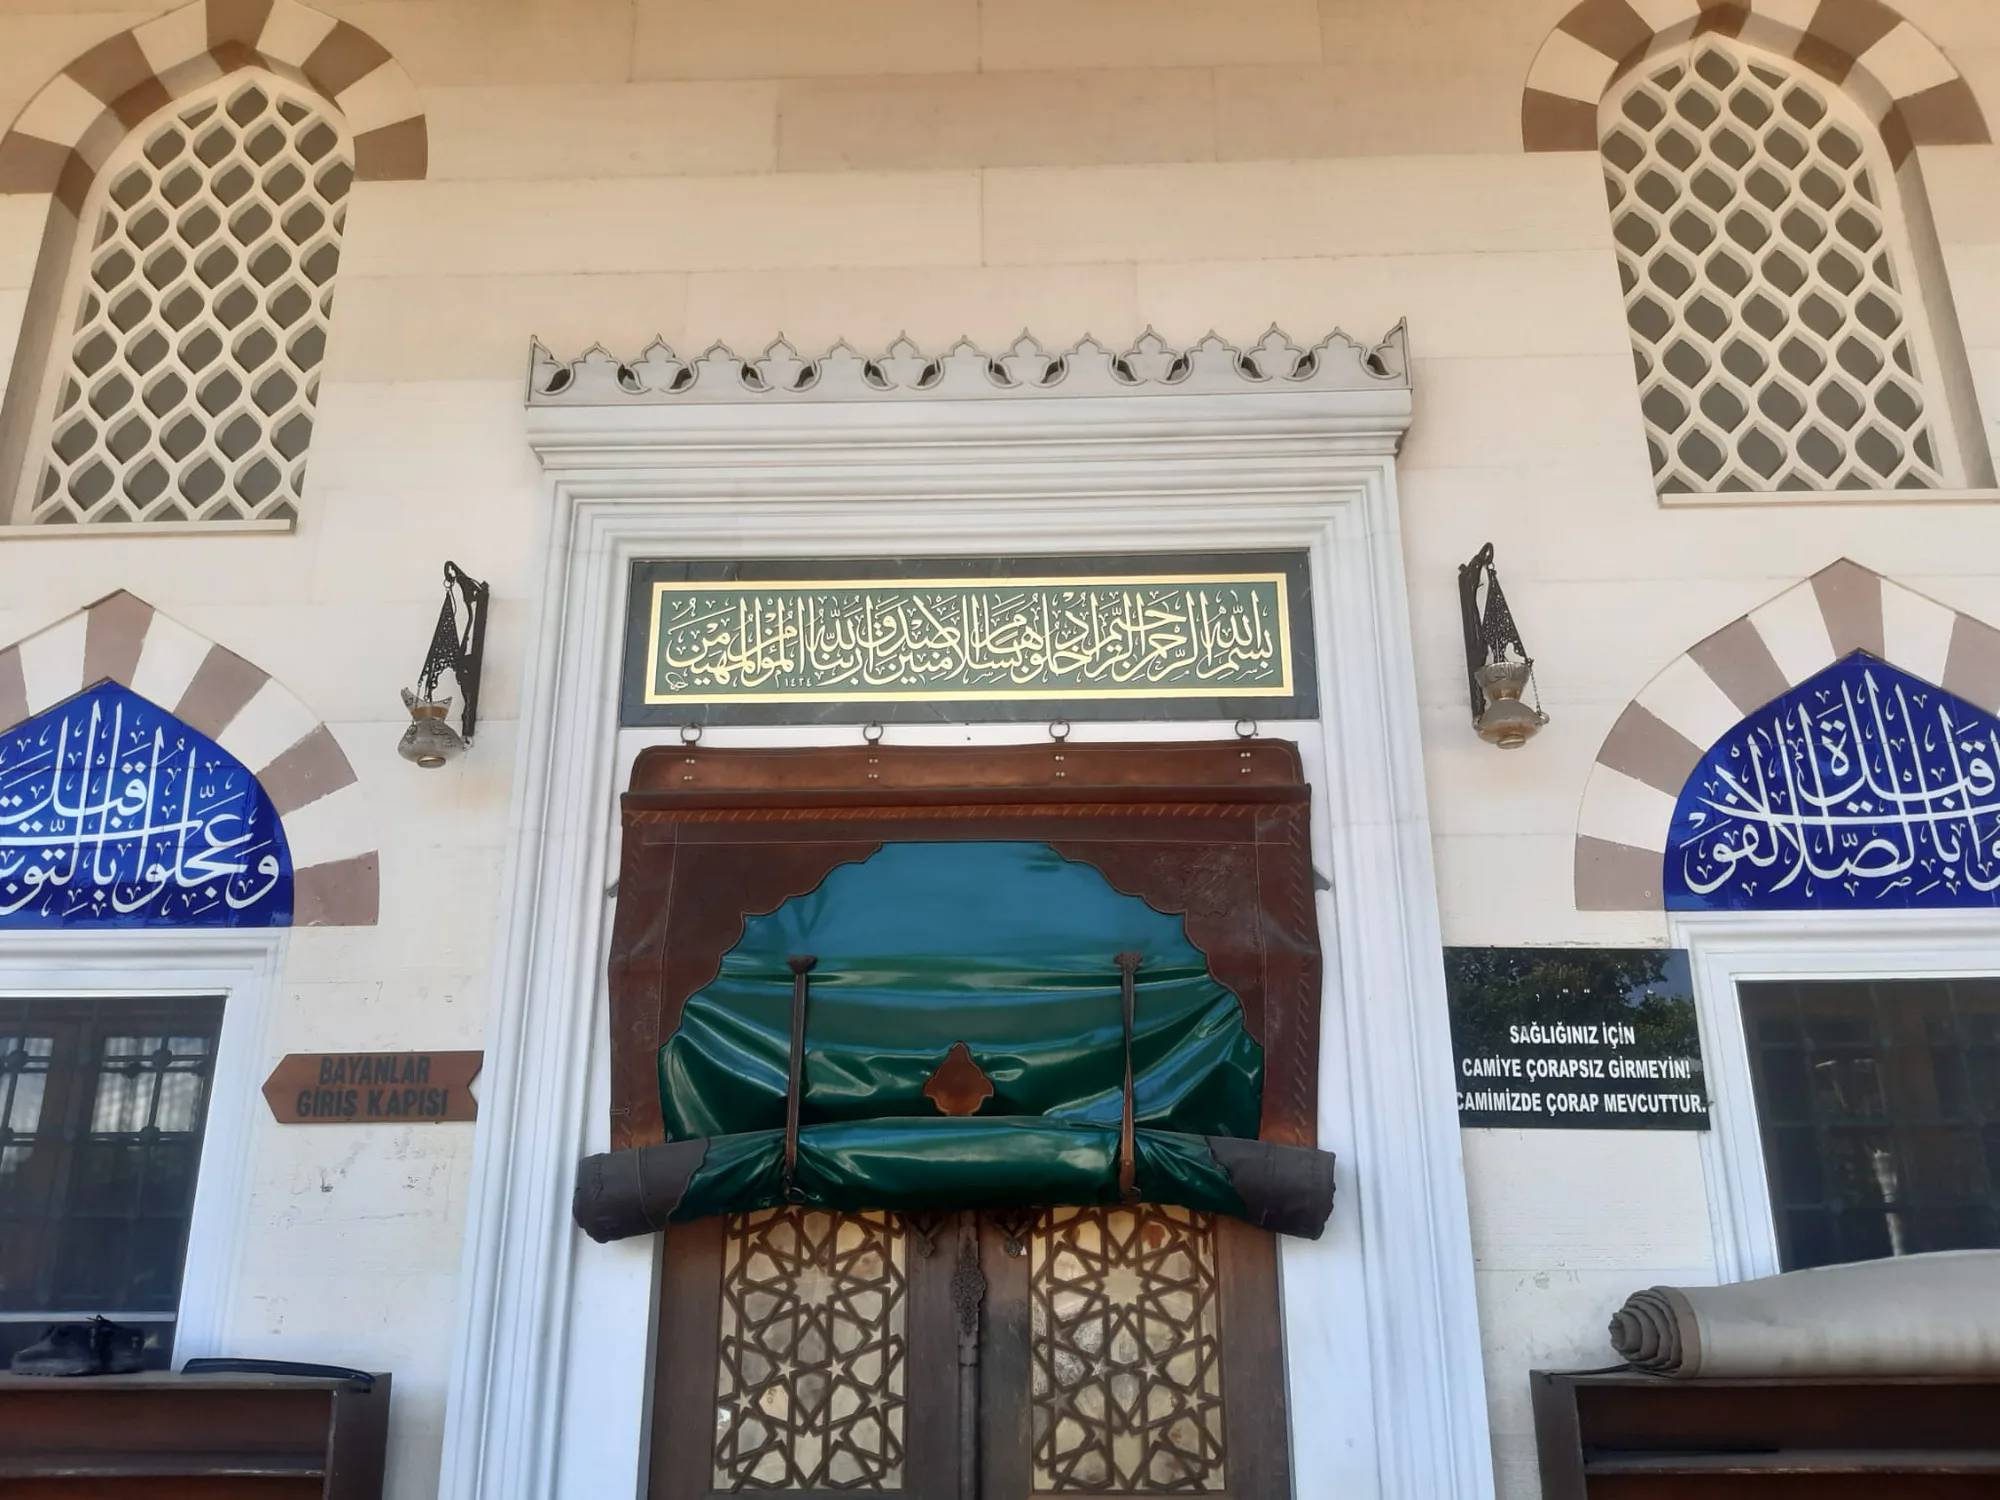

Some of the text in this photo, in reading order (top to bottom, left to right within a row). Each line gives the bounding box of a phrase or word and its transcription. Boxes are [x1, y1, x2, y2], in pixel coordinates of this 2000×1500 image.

[1509, 1021, 1635, 1049] SAĞLIĞINIZ İÇİN
[318, 1055, 431, 1085] BAYANLAR
[1462, 1054, 1691, 1082] CAMİYE ÇORAPSIZ GİRMEYİN!
[366, 1086, 450, 1117] KAPISI
[1546, 1092, 1599, 1117] ÇORAP
[1604, 1093, 1707, 1114] MEVCUTTUR.
